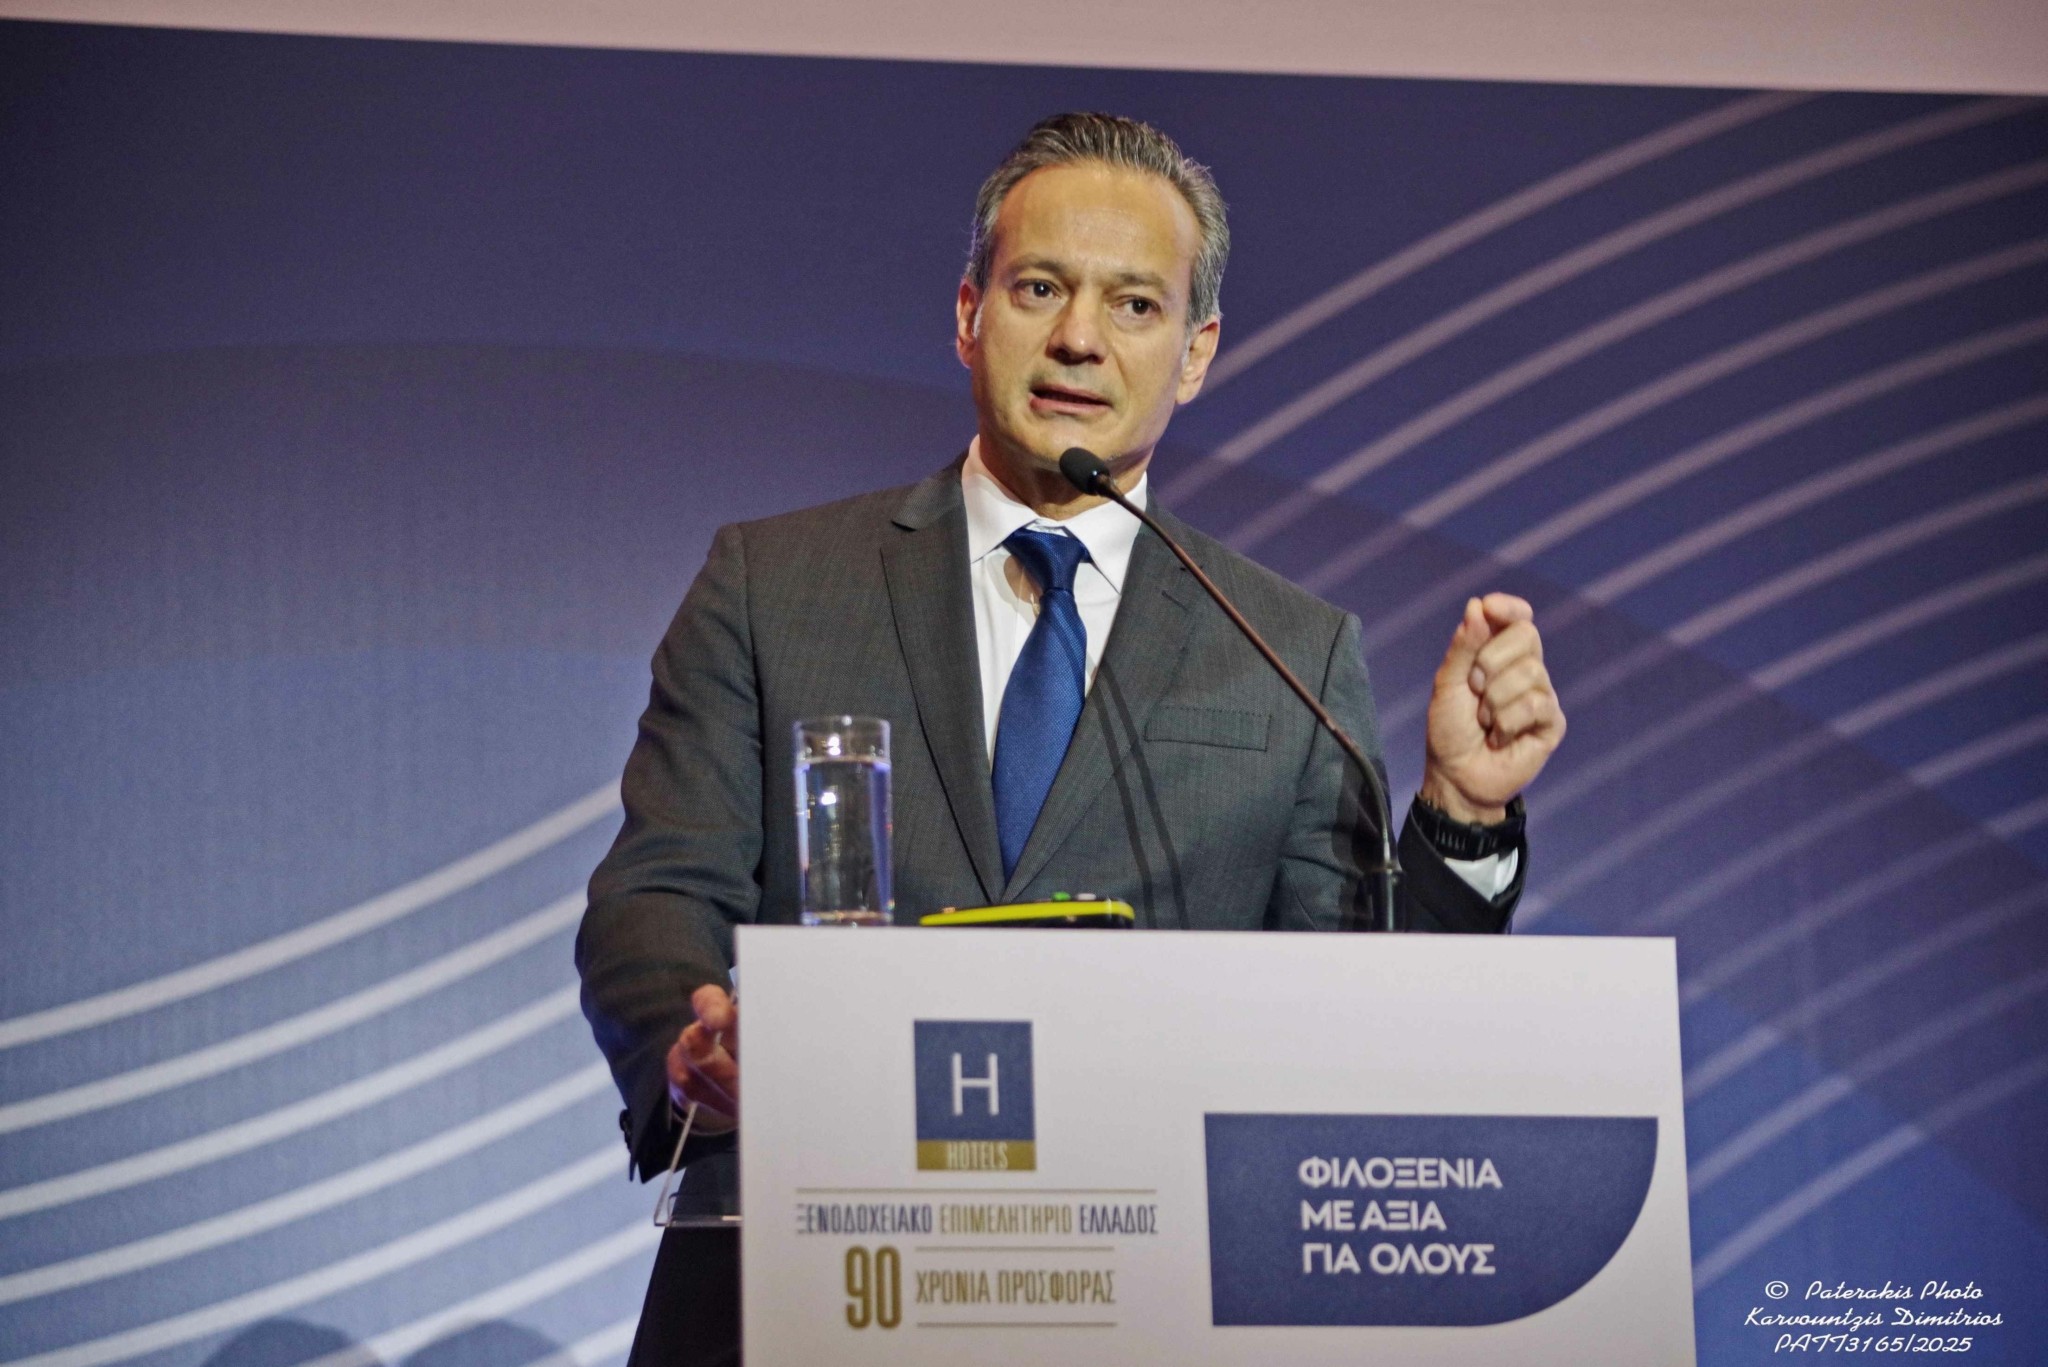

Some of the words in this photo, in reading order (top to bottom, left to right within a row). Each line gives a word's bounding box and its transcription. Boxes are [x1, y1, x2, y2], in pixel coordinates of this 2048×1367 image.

[952, 1052, 999, 1116] H
[946, 1142, 1009, 1170] HOTELS
[1298, 1157, 1503, 1189] ΦΙΛΟΞΕΝΙΑ
[796, 1203, 933, 1235] ΞΕΝΟΔΟΧΕΙΑΚΟ
[940, 1204, 1073, 1235] ΕΠΙΜΕΛΗΤΗΡΙΟ
[1079, 1203, 1159, 1235] ΕΛΛΑΔΟΣ
[1301, 1201, 1355, 1231] ΜΕ
[1360, 1201, 1447, 1231] ΑΞΙΑ
[1303, 1245, 1360, 1275] ΓΙΑ
[1369, 1244, 1495, 1275] ΟΛΟΥΣ
[844, 1245, 902, 1330] 90
[916, 1270, 990, 1304] ΧΡΟΝΙΑ
[997, 1270, 1117, 1304] ΠΡΟΣΦΟΡΑΣ
